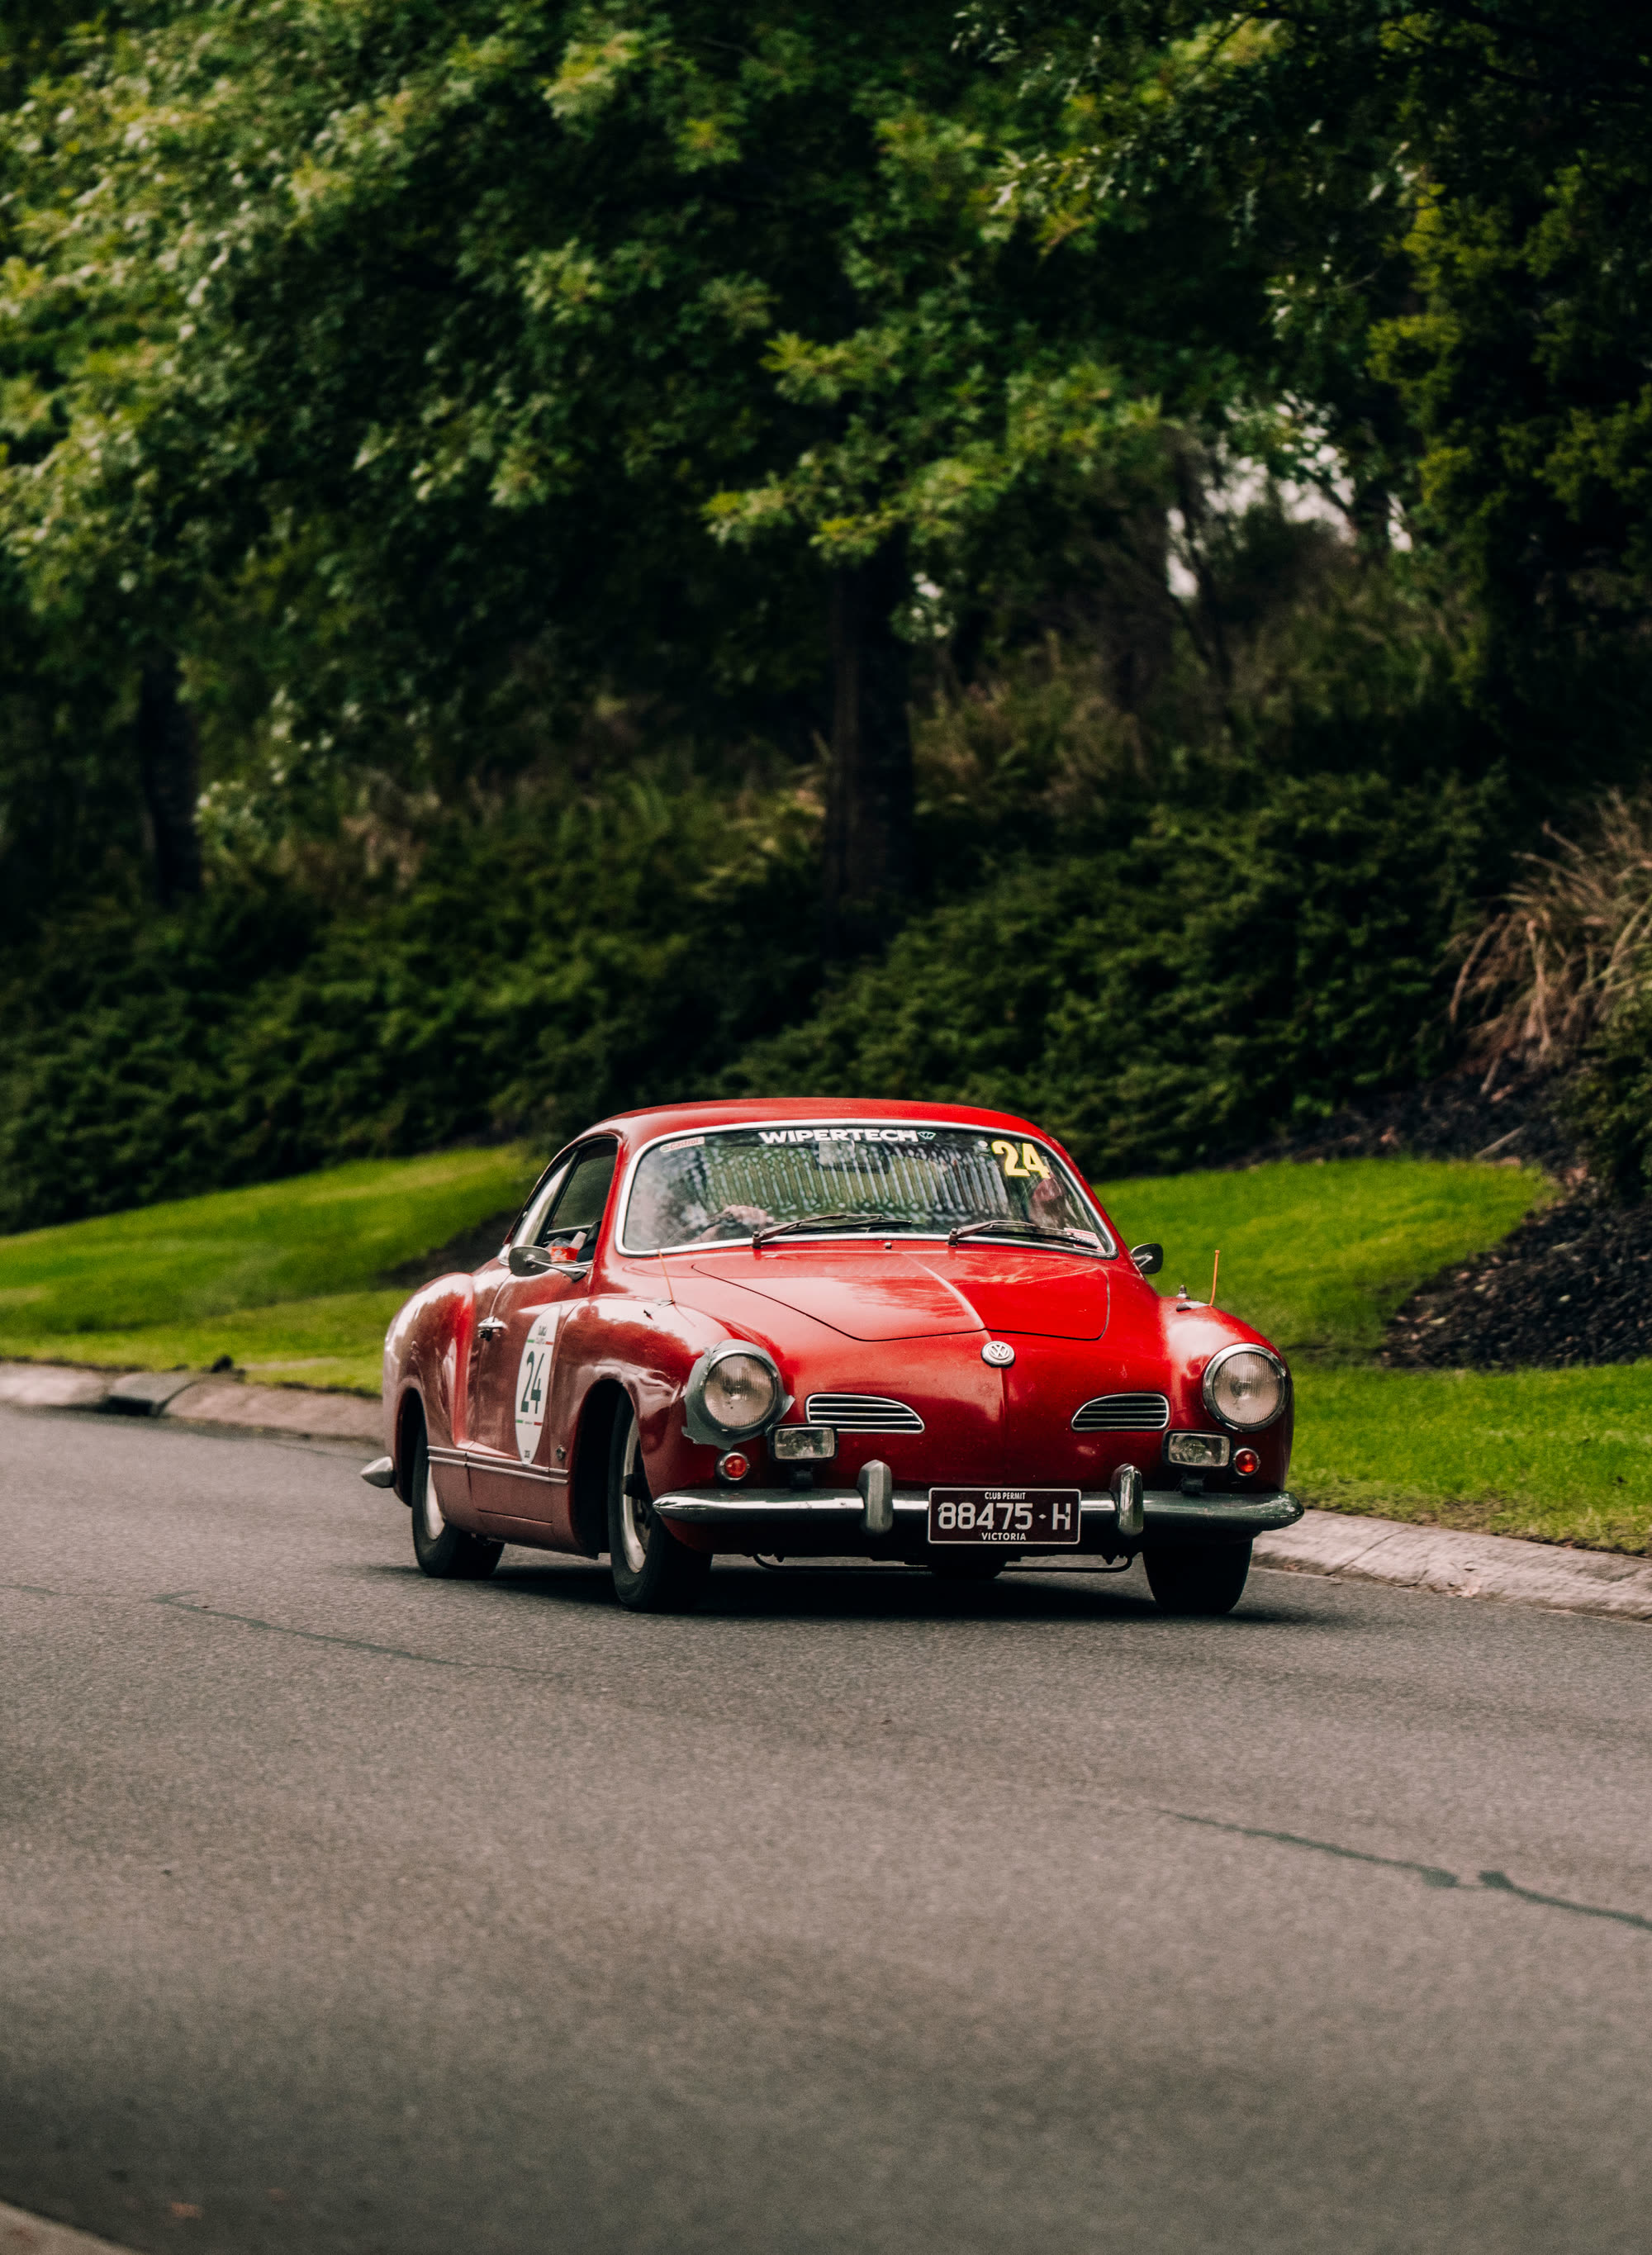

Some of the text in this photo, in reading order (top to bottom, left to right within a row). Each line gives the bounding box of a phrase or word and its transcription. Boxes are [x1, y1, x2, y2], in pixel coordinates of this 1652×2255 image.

[758, 1128, 919, 1144] WIPERTECH
[670, 1138, 699, 1149] Castrol
[991, 1140, 1051, 1179] 24
[520, 1351, 545, 1414] 24
[985, 1492, 1026, 1500] CLUB PERMIT
[981, 1531, 1027, 1541] VICTORIA
